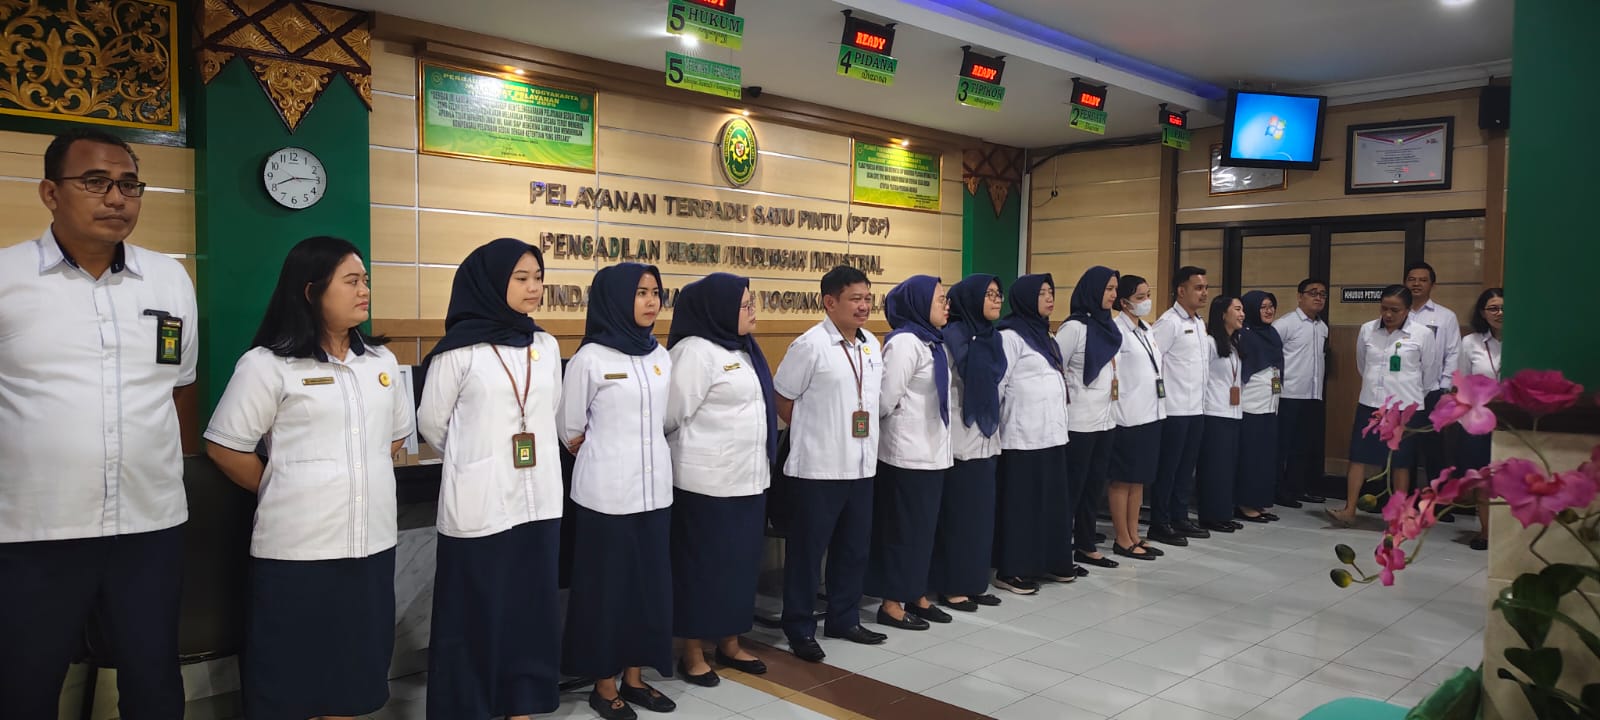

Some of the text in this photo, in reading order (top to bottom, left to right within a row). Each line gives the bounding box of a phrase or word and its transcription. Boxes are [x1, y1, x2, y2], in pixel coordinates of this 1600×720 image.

[670, 5, 740, 32] 5 HUKUM
[856, 31, 886, 50] READY
[840, 51, 894, 74] 4 PIDANA
[668, 57, 684, 84] 5
[971, 65, 997, 80] READY
[958, 81, 969, 102] 3
[1071, 108, 1080, 126] 2
[280, 154, 286, 163] 11
[290, 153, 298, 161] 12
[272, 162, 279, 170] 10
[312, 166, 317, 175] 2
[267, 172, 273, 180] 9
[316, 176, 321, 185] 3
[272, 184, 277, 192] 8
[310, 187, 316, 196] 4
[281, 192, 287, 200] 7
[291, 196, 298, 205] 6
[303, 194, 309, 202] 5
[529, 181, 890, 238] PELAYANAN TERPADU SATU PINTU (PTSP)
[539, 232, 661, 262] PENGADILAN
[665, 241, 720, 265] NEGERI
[810, 251, 884, 275] INDUSTRIAL
